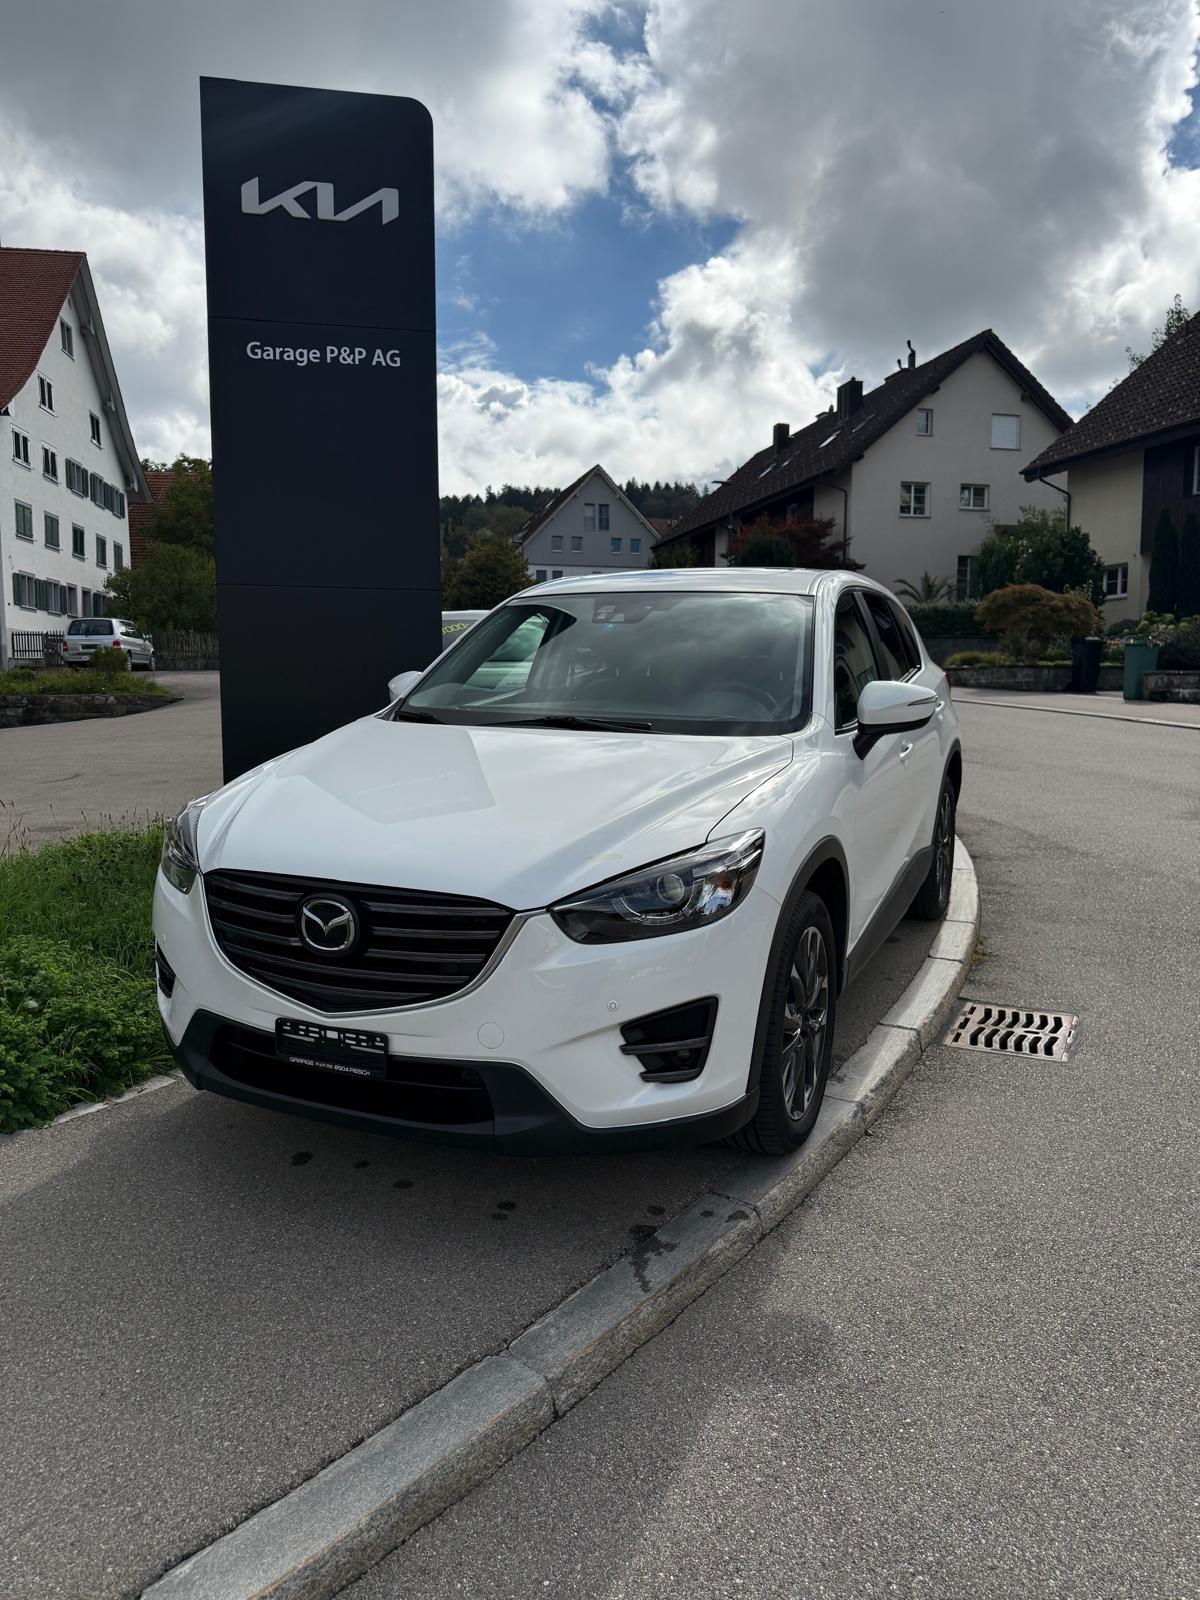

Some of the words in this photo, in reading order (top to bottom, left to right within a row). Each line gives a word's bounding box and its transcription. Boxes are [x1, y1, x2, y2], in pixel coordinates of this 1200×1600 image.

[241, 176, 400, 226] KIA
[246, 341, 321, 367] Garage
[326, 346, 367, 365] P&P
[371, 349, 401, 367] AG
[289, 1057, 314, 1066] GARAGE
[334, 1065, 349, 1073] 8904
